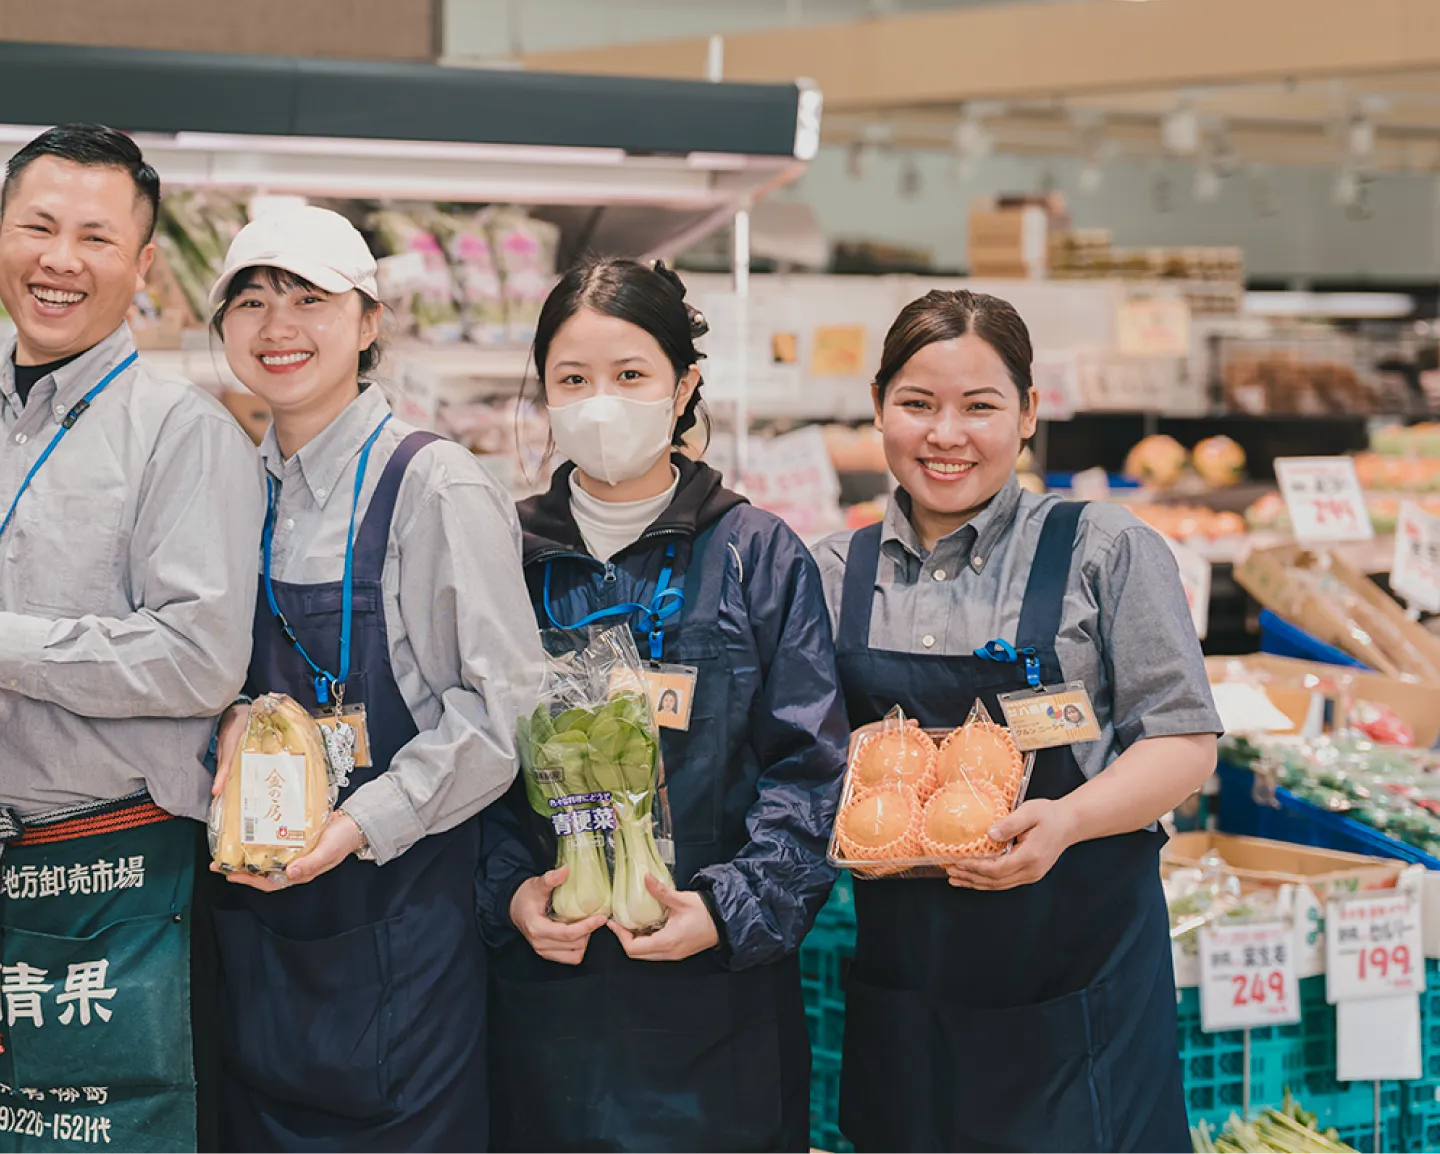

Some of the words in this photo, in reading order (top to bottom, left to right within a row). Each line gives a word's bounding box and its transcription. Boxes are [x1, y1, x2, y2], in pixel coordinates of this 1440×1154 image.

[263, 768, 287, 823] 金の房
[552, 807, 616, 836] 青梗菜
[1357, 945, 1410, 979] 199
[1232, 970, 1284, 1007] 249
